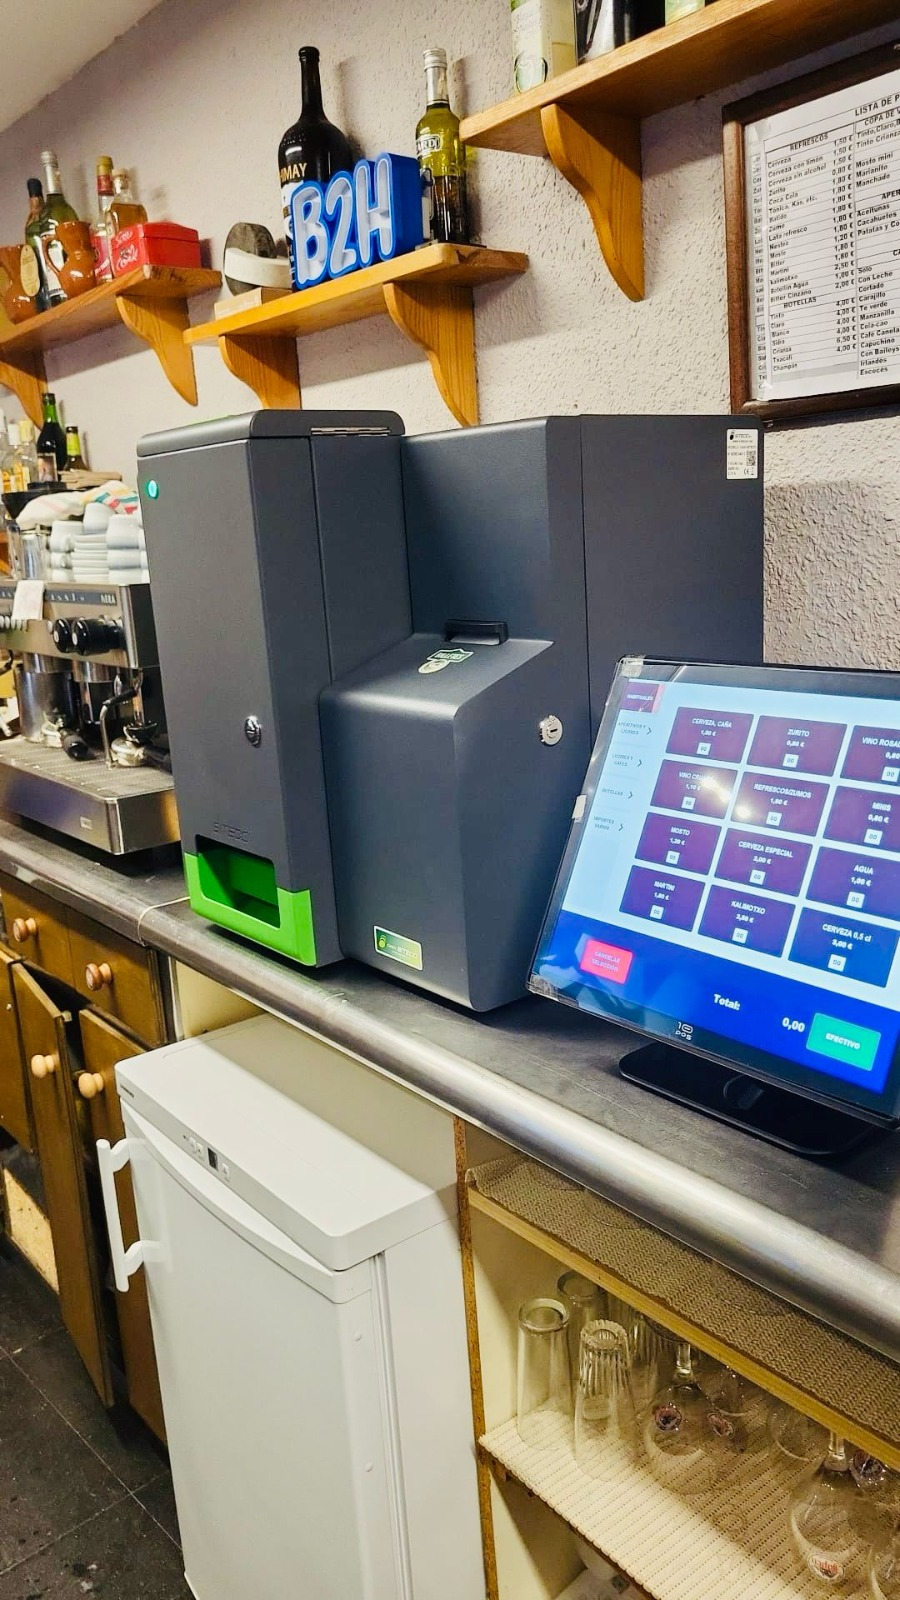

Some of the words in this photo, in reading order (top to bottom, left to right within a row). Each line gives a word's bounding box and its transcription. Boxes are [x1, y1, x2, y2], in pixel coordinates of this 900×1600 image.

[855, 103, 878, 116] LISTA
[882, 97, 891, 107] DE
[865, 115, 883, 126] COPA
[790, 133, 828, 151] REFRESCOS
[857, 139, 873, 148] Tinto
[768, 157, 791, 168] Cerveza
[856, 158, 875, 168] Mosto
[878, 152, 893, 160] mini
[768, 167, 791, 177] Cerveza
[794, 162, 804, 170] con
[769, 176, 792, 186] Cerveza
[804, 163, 826, 176] alcohol
[856, 164, 887, 178] Marianito
[856, 173, 890, 187] Manchado
[769, 197, 783, 205] Coca
[786, 192, 798, 200] Cola
[857, 204, 889, 217] Aceitunas
[292, 154, 394, 287] B2H
[857, 212, 897, 226] Cacahuetes
[783, 227, 807, 237] refresco
[858, 226, 882, 236] Patatas
[835, 234, 847, 242] 1,20
[835, 243, 848, 251] 1,80
[835, 262, 848, 270] 2,50
[872, 271, 893, 279] Leche
[788, 290, 811, 298] Cinzano
[835, 281, 849, 289] 2,00
[859, 283, 884, 292] Cortado
[859, 292, 885, 301] Carajillo
[784, 297, 816, 308] BOTELLAS
[836, 299, 849, 307] 4,00
[860, 309, 894, 320] Manzanilla
[837, 327, 849, 335] 4,00
[877, 327, 899, 336] Canela
[861, 338, 895, 348] Capuchino
[692, 718, 716, 727] CERVEZA,
[787, 728, 810, 737] ZURITO
[862, 737, 878, 745] VINO
[872, 802, 891, 811] MINIS
[868, 814, 882, 822] 0,80
[671, 827, 691, 836] MOSTO
[739, 841, 764, 851] CERVEZA
[765, 846, 794, 858] ESPECIAL
[854, 865, 873, 875] AGUA
[654, 881, 675, 891] MARTINI
[851, 877, 865, 885] 1,00
[731, 901, 765, 914] KALIMOTXO
[823, 924, 852, 937] CERVEZA
[853, 932, 864, 941] 0,5
[595, 951, 620, 962] CANCELAR
[714, 994, 740, 1010] Total:
[782, 1017, 805, 1032] 0,00
[826, 1033, 860, 1049] EFECTIVO
